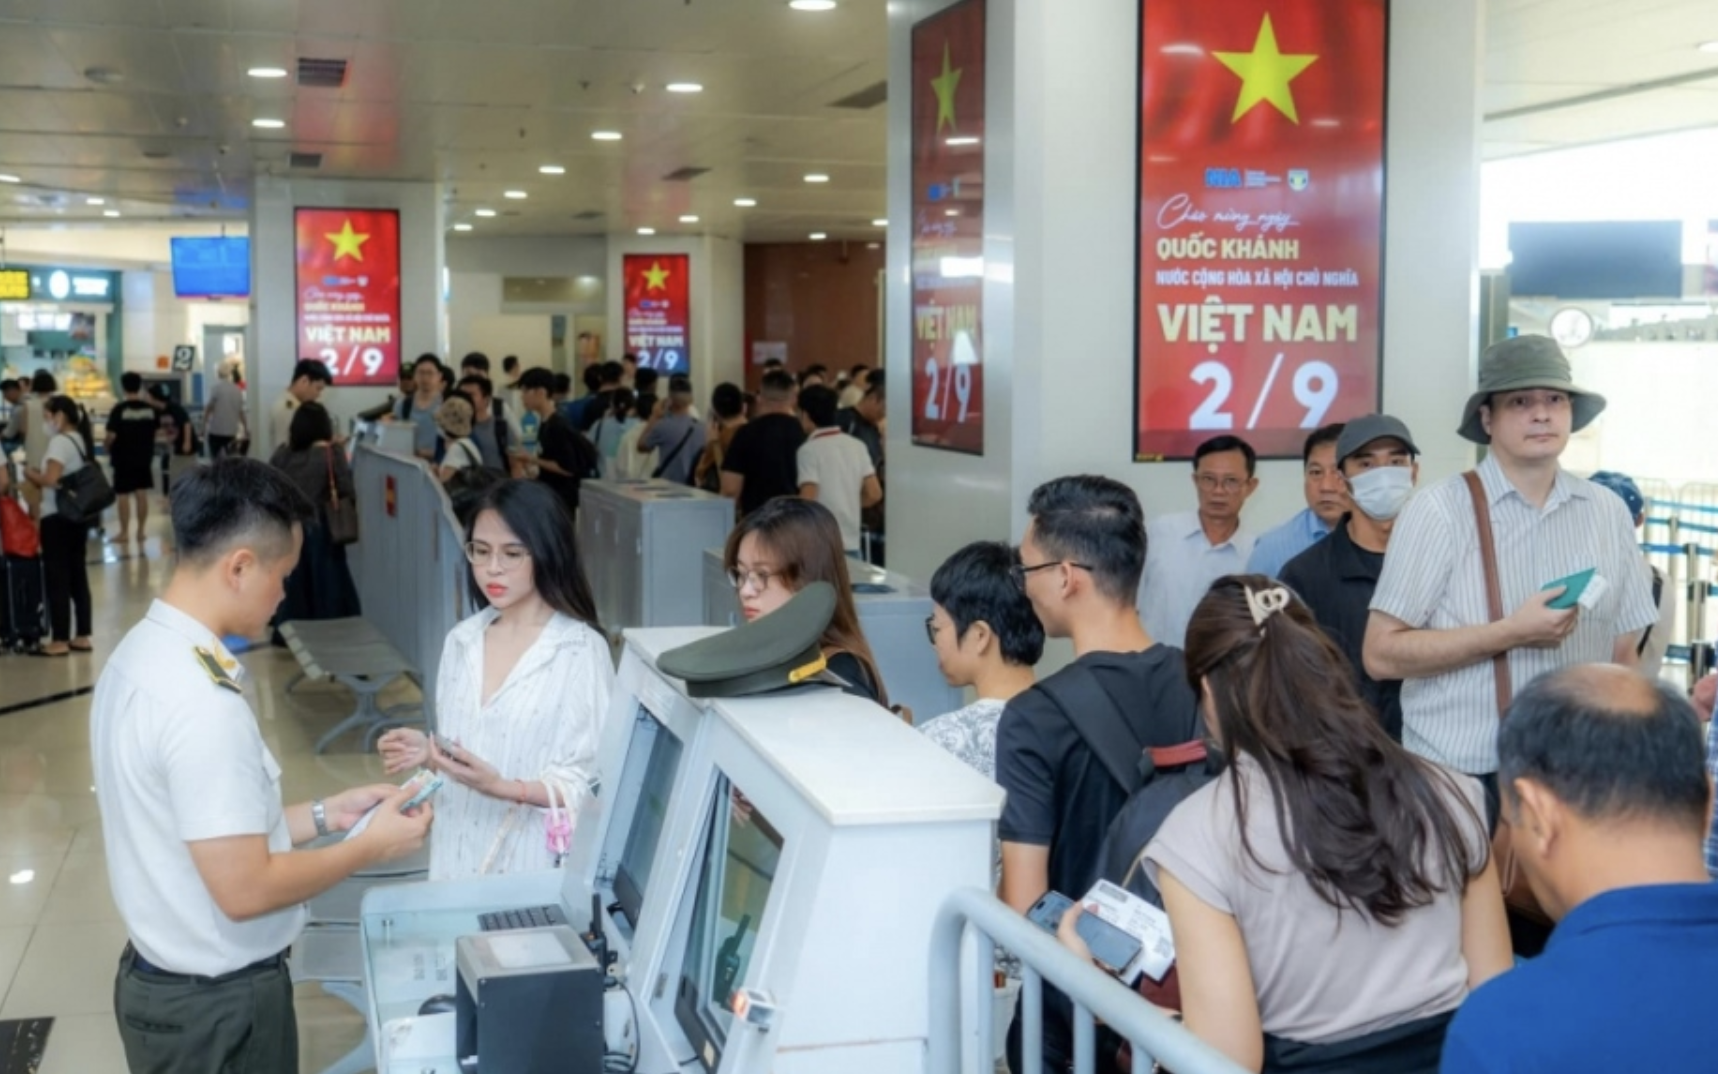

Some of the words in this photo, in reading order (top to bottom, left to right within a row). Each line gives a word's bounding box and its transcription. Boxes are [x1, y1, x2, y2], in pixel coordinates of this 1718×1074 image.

[1156, 232, 1217, 260] QUỐC
[1221, 234, 1299, 259] KHÁNH
[1192, 267, 1225, 289] CỘNG
[1227, 268, 1252, 285] HÒA
[1254, 267, 1271, 285] XÃ
[1273, 268, 1293, 290] HỘI
[1322, 268, 1359, 286] NGHĨA
[305, 324, 346, 345] VIỆT
[349, 326, 391, 344] NAM
[1157, 295, 1254, 353] VIỆT
[1263, 304, 1357, 342] NAM
